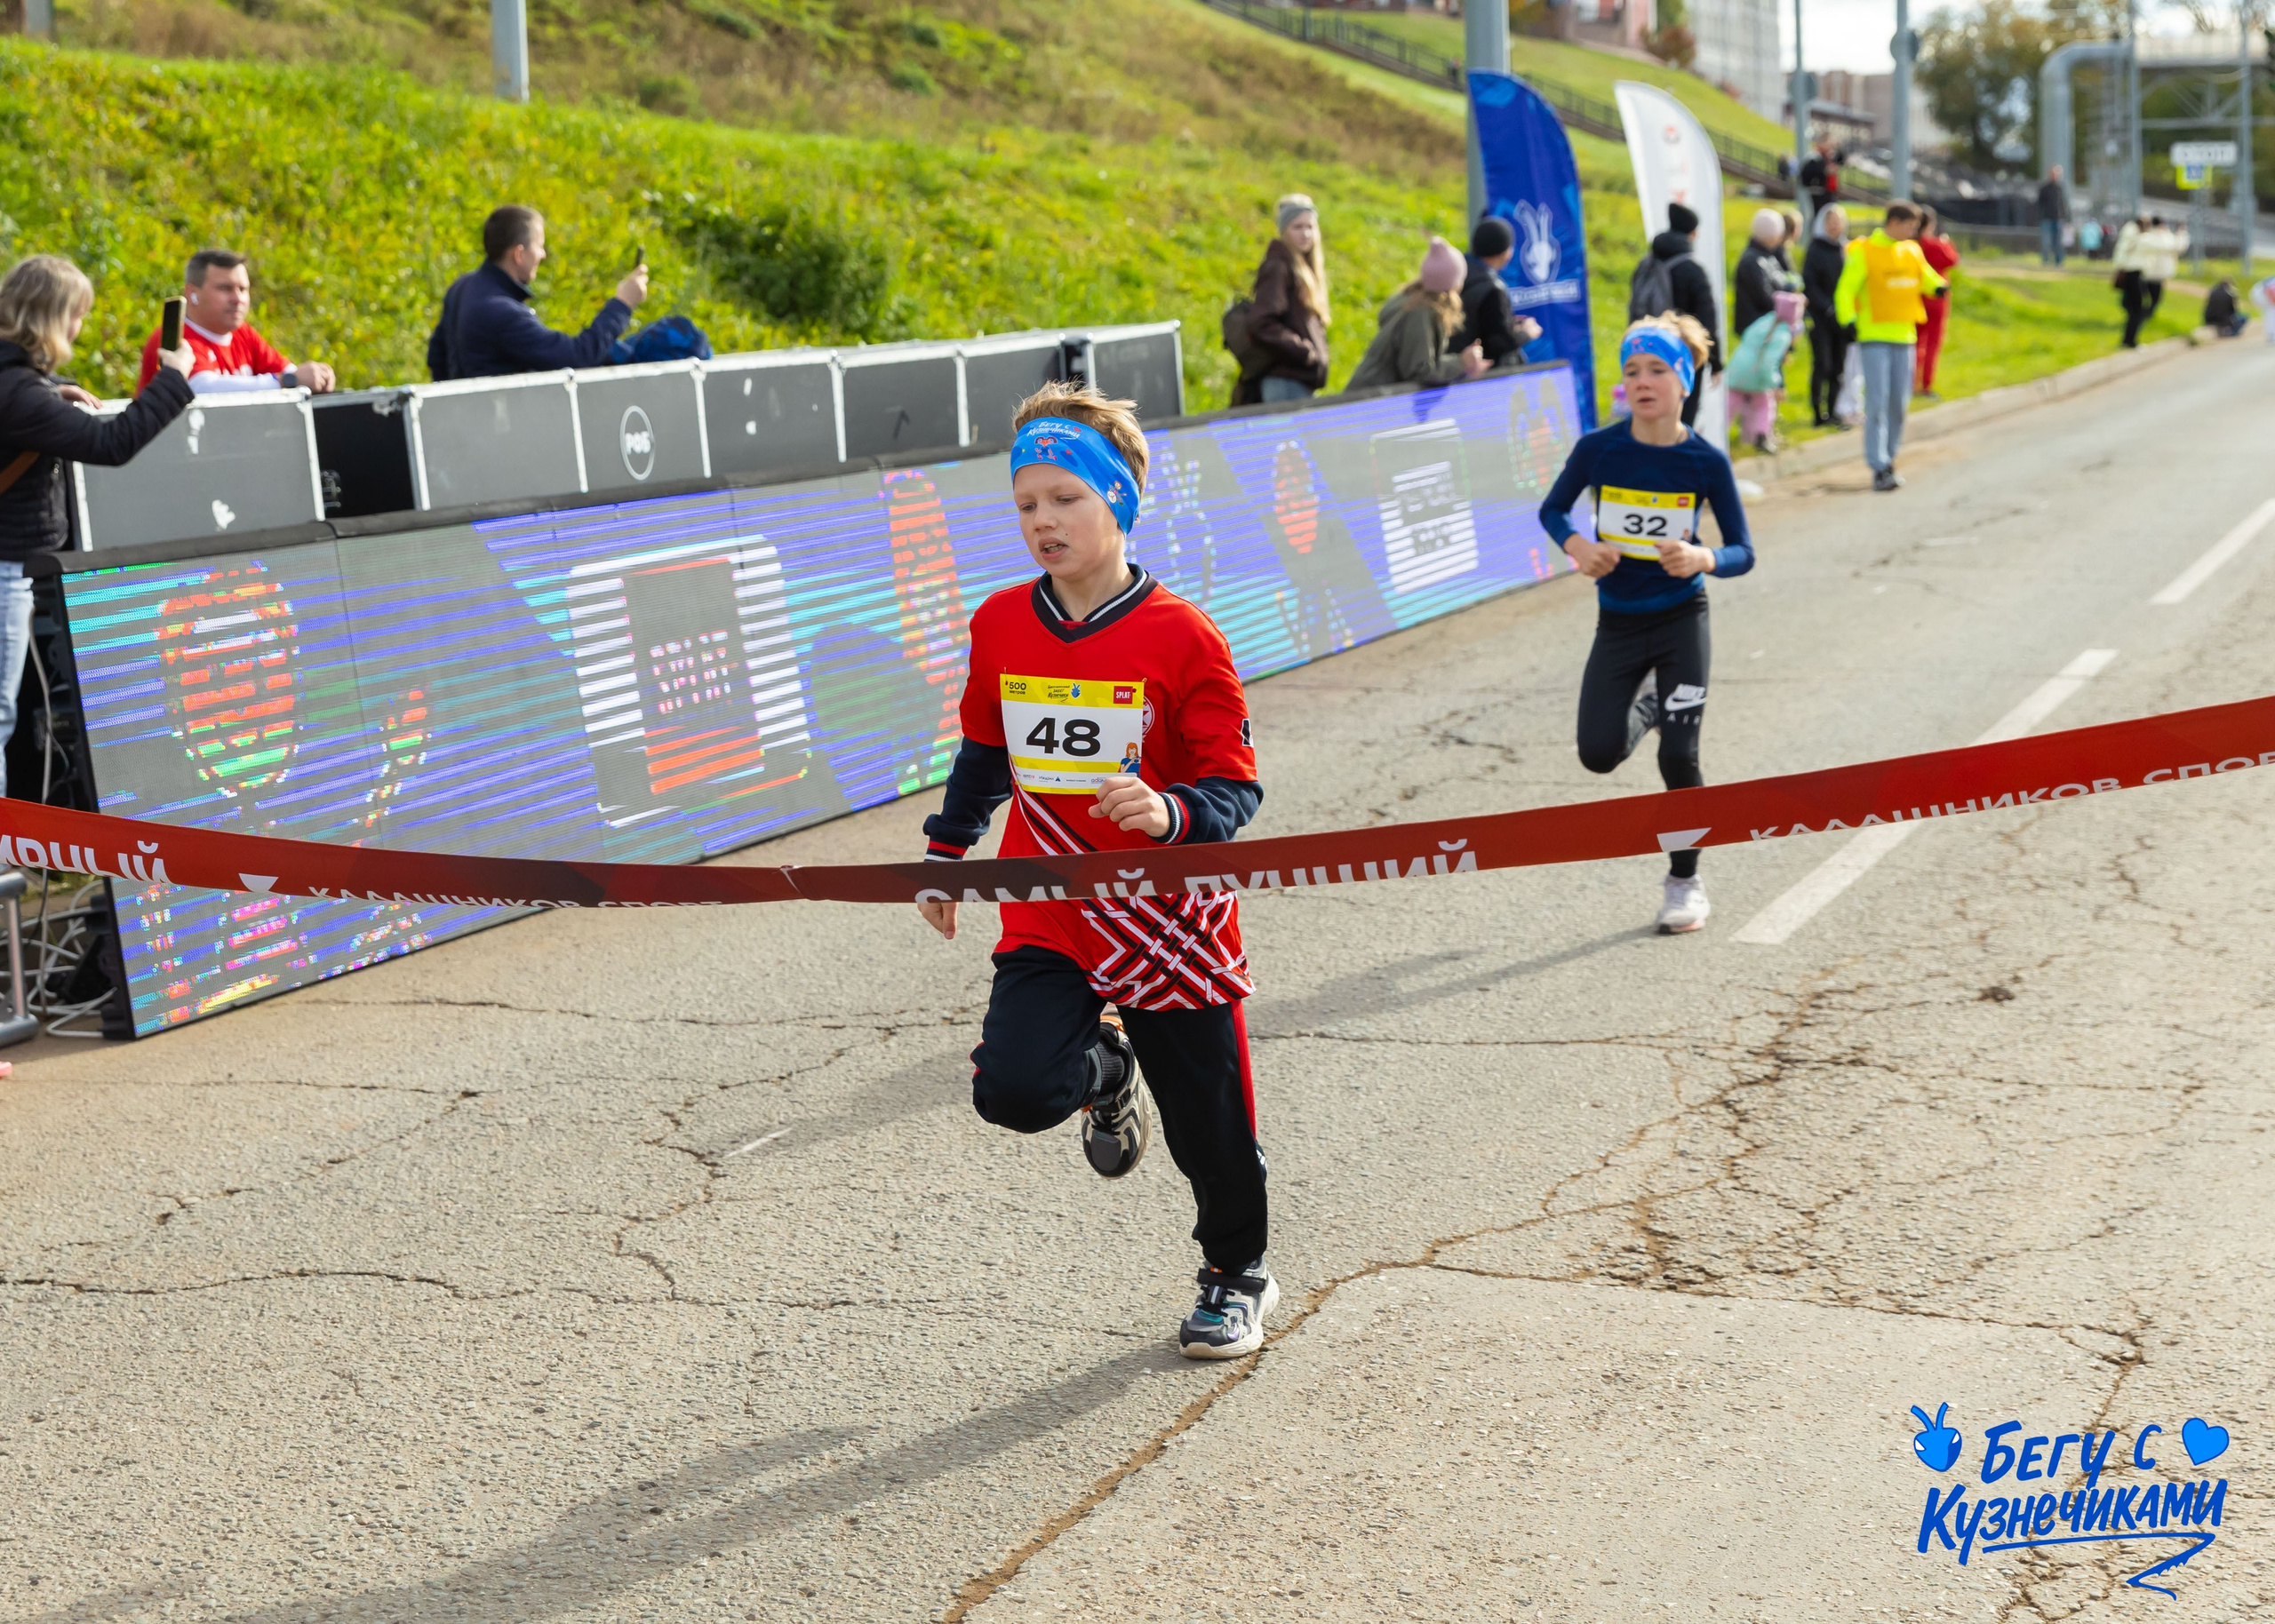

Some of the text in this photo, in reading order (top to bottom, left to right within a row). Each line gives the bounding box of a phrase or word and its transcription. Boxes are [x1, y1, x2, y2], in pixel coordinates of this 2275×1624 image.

[1623, 513, 1667, 537] 32
[1009, 681, 1027, 691] 500
[1026, 717, 1101, 757] 48
